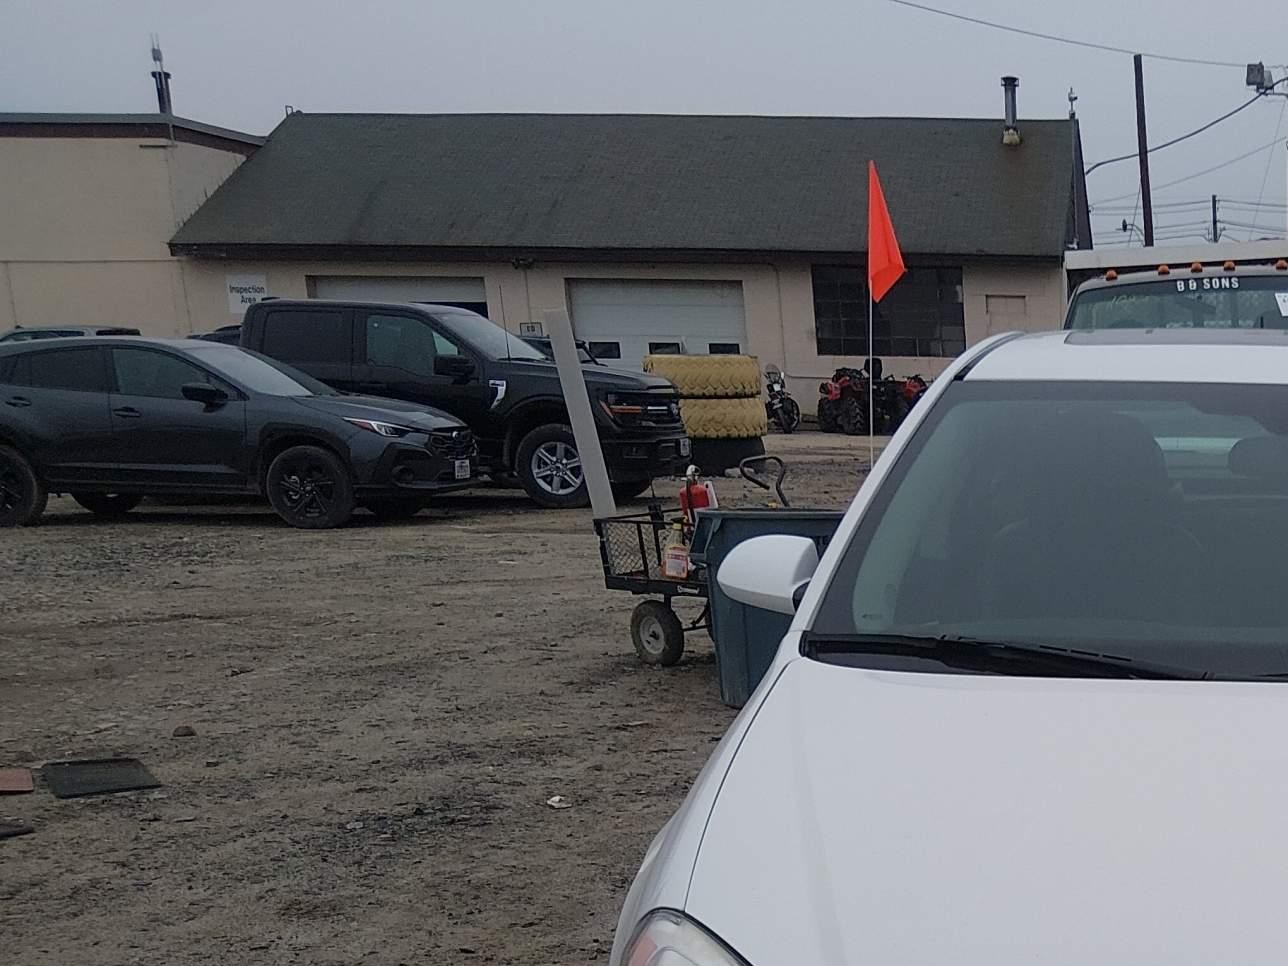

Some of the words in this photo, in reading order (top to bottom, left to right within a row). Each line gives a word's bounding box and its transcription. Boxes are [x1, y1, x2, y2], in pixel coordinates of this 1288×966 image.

[229, 284, 265, 294] Inspection
[1176, 280, 1185, 291] B
[1203, 277, 1239, 289] SONS
